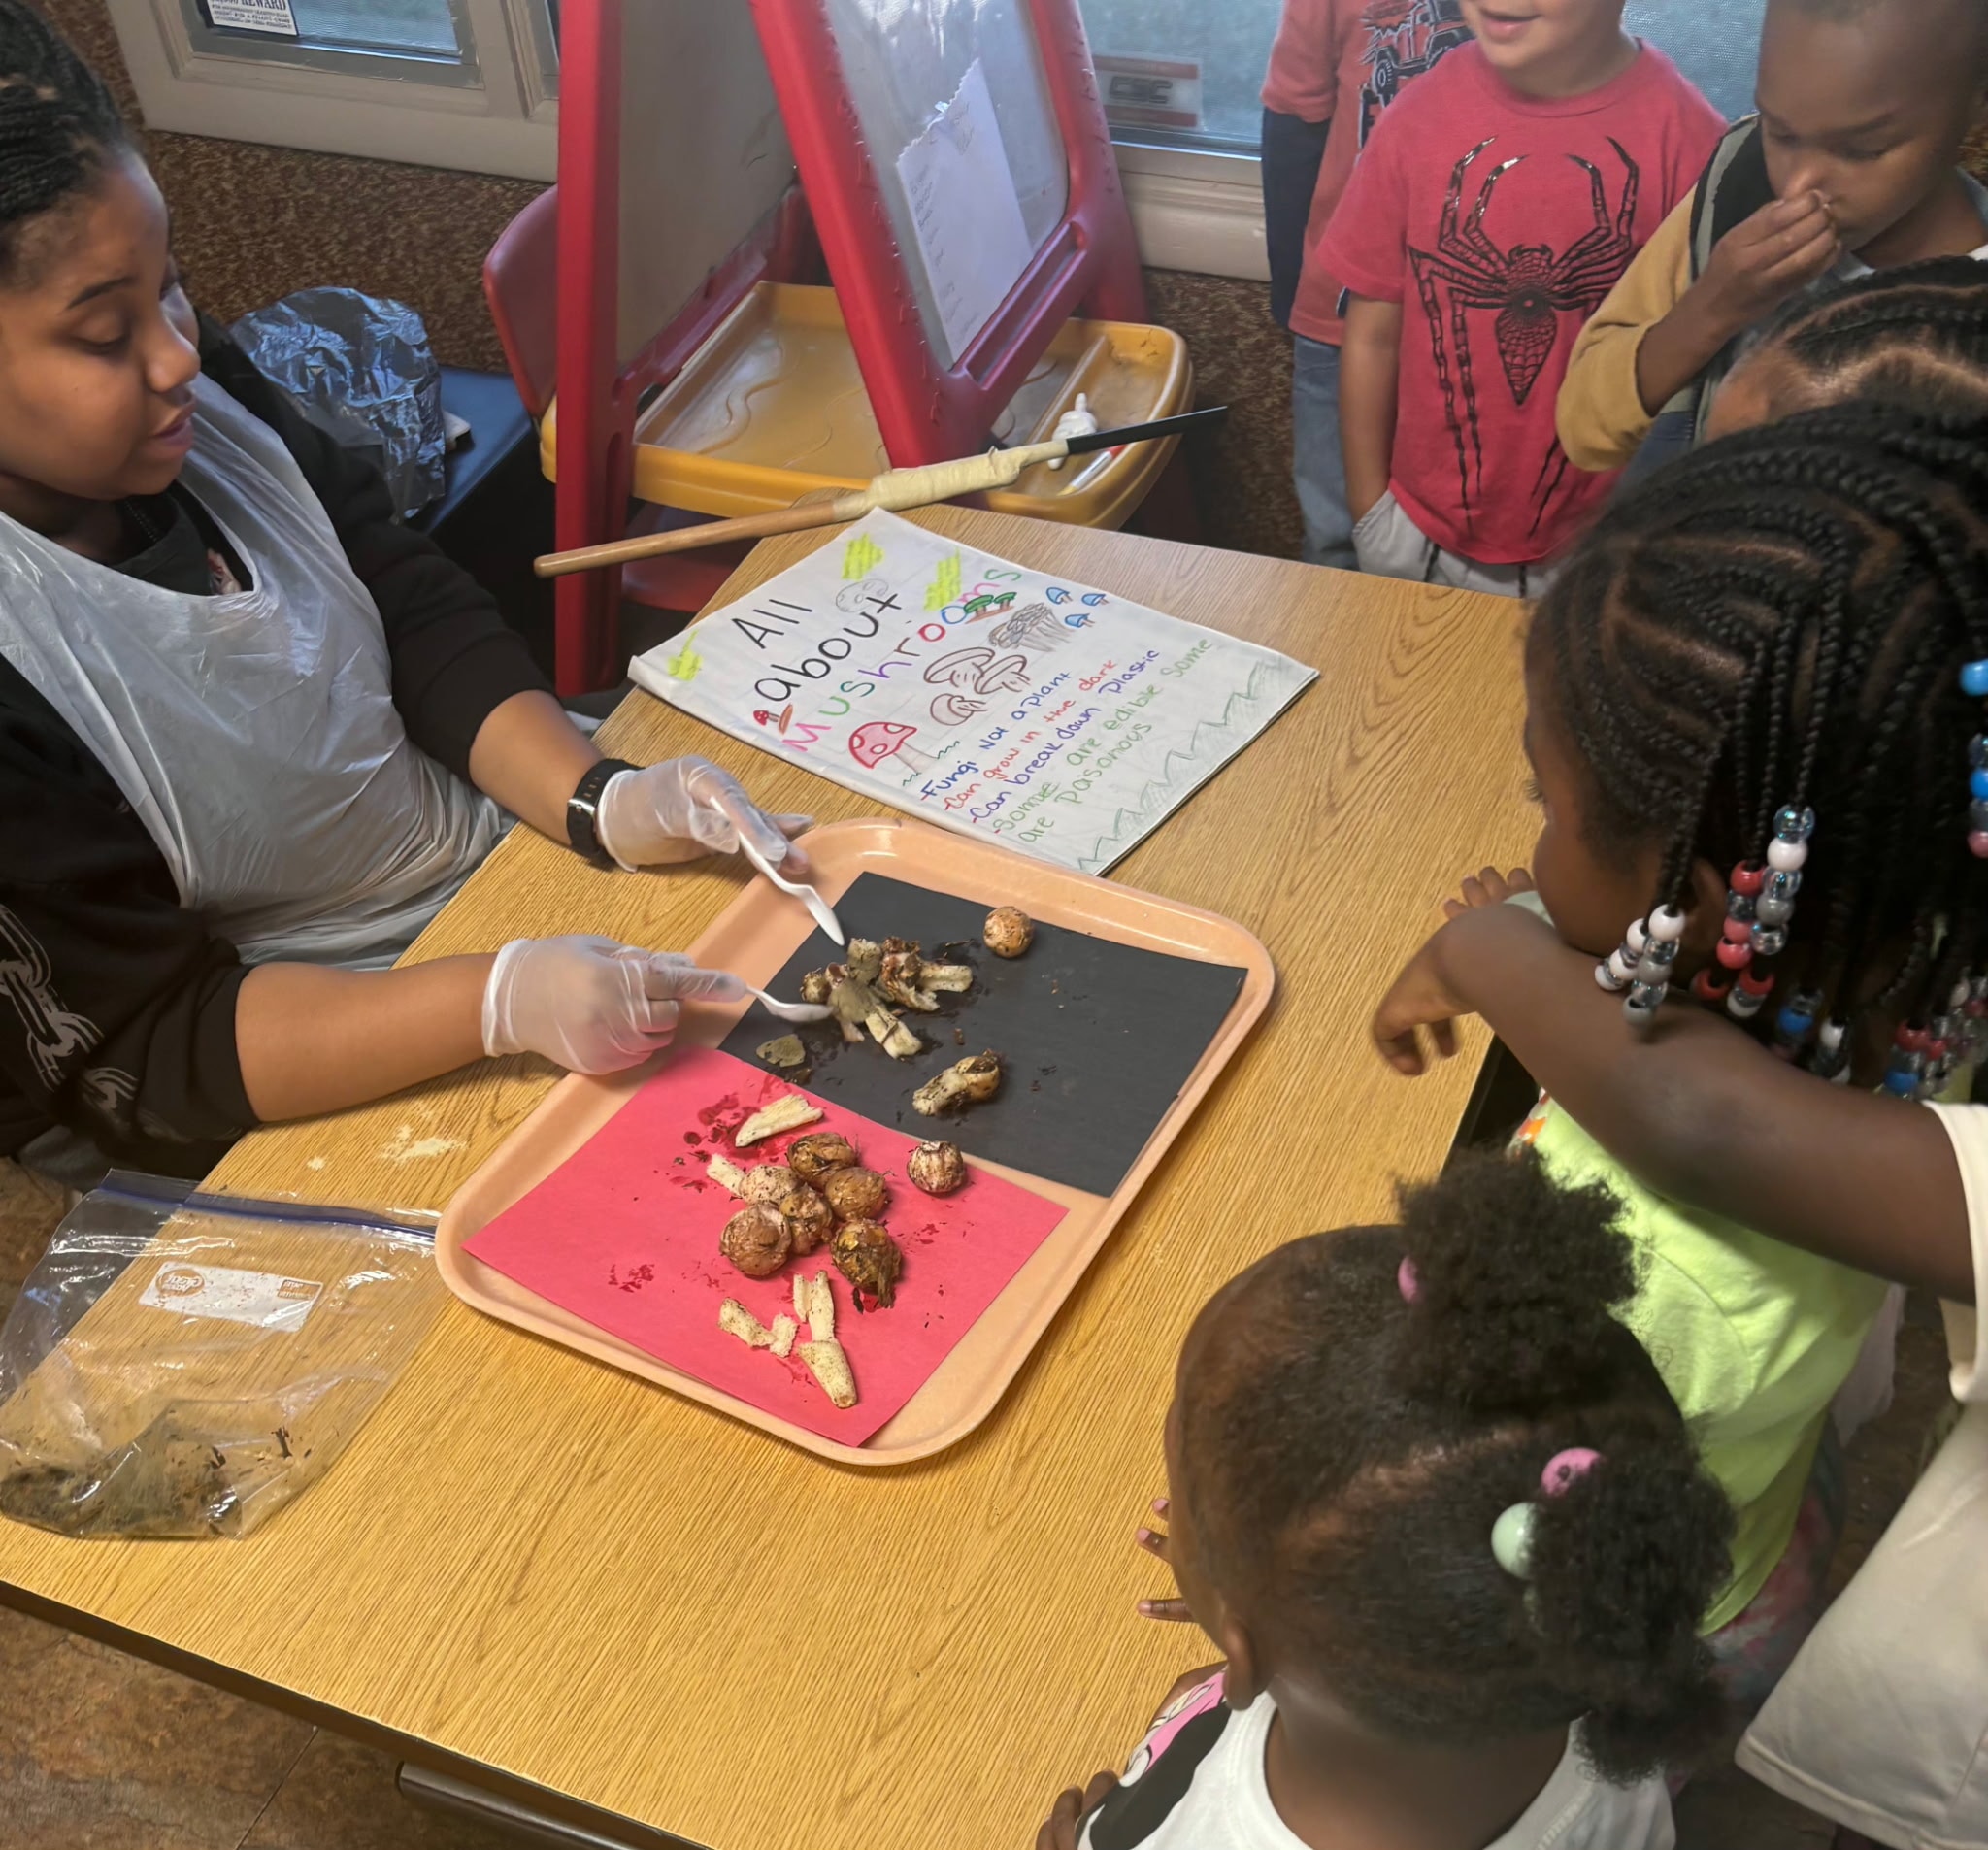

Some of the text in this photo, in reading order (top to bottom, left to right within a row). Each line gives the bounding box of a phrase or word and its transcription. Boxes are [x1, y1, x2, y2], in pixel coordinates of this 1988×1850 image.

[732, 599, 812, 649] All
[754, 593, 902, 702] about
[979, 727, 1010, 750] Not
[1011, 710, 1027, 721] a
[983, 749, 1020, 782] grow
[1020, 731, 1042, 744] in
[1044, 699, 1076, 723] the
[1078, 660, 1118, 692] dark
[1011, 743, 1064, 785] break
[1056, 707, 1102, 740] down
[1066, 737, 1103, 766] are
[1103, 684, 1162, 730] edible
[1018, 816, 1055, 843] are
